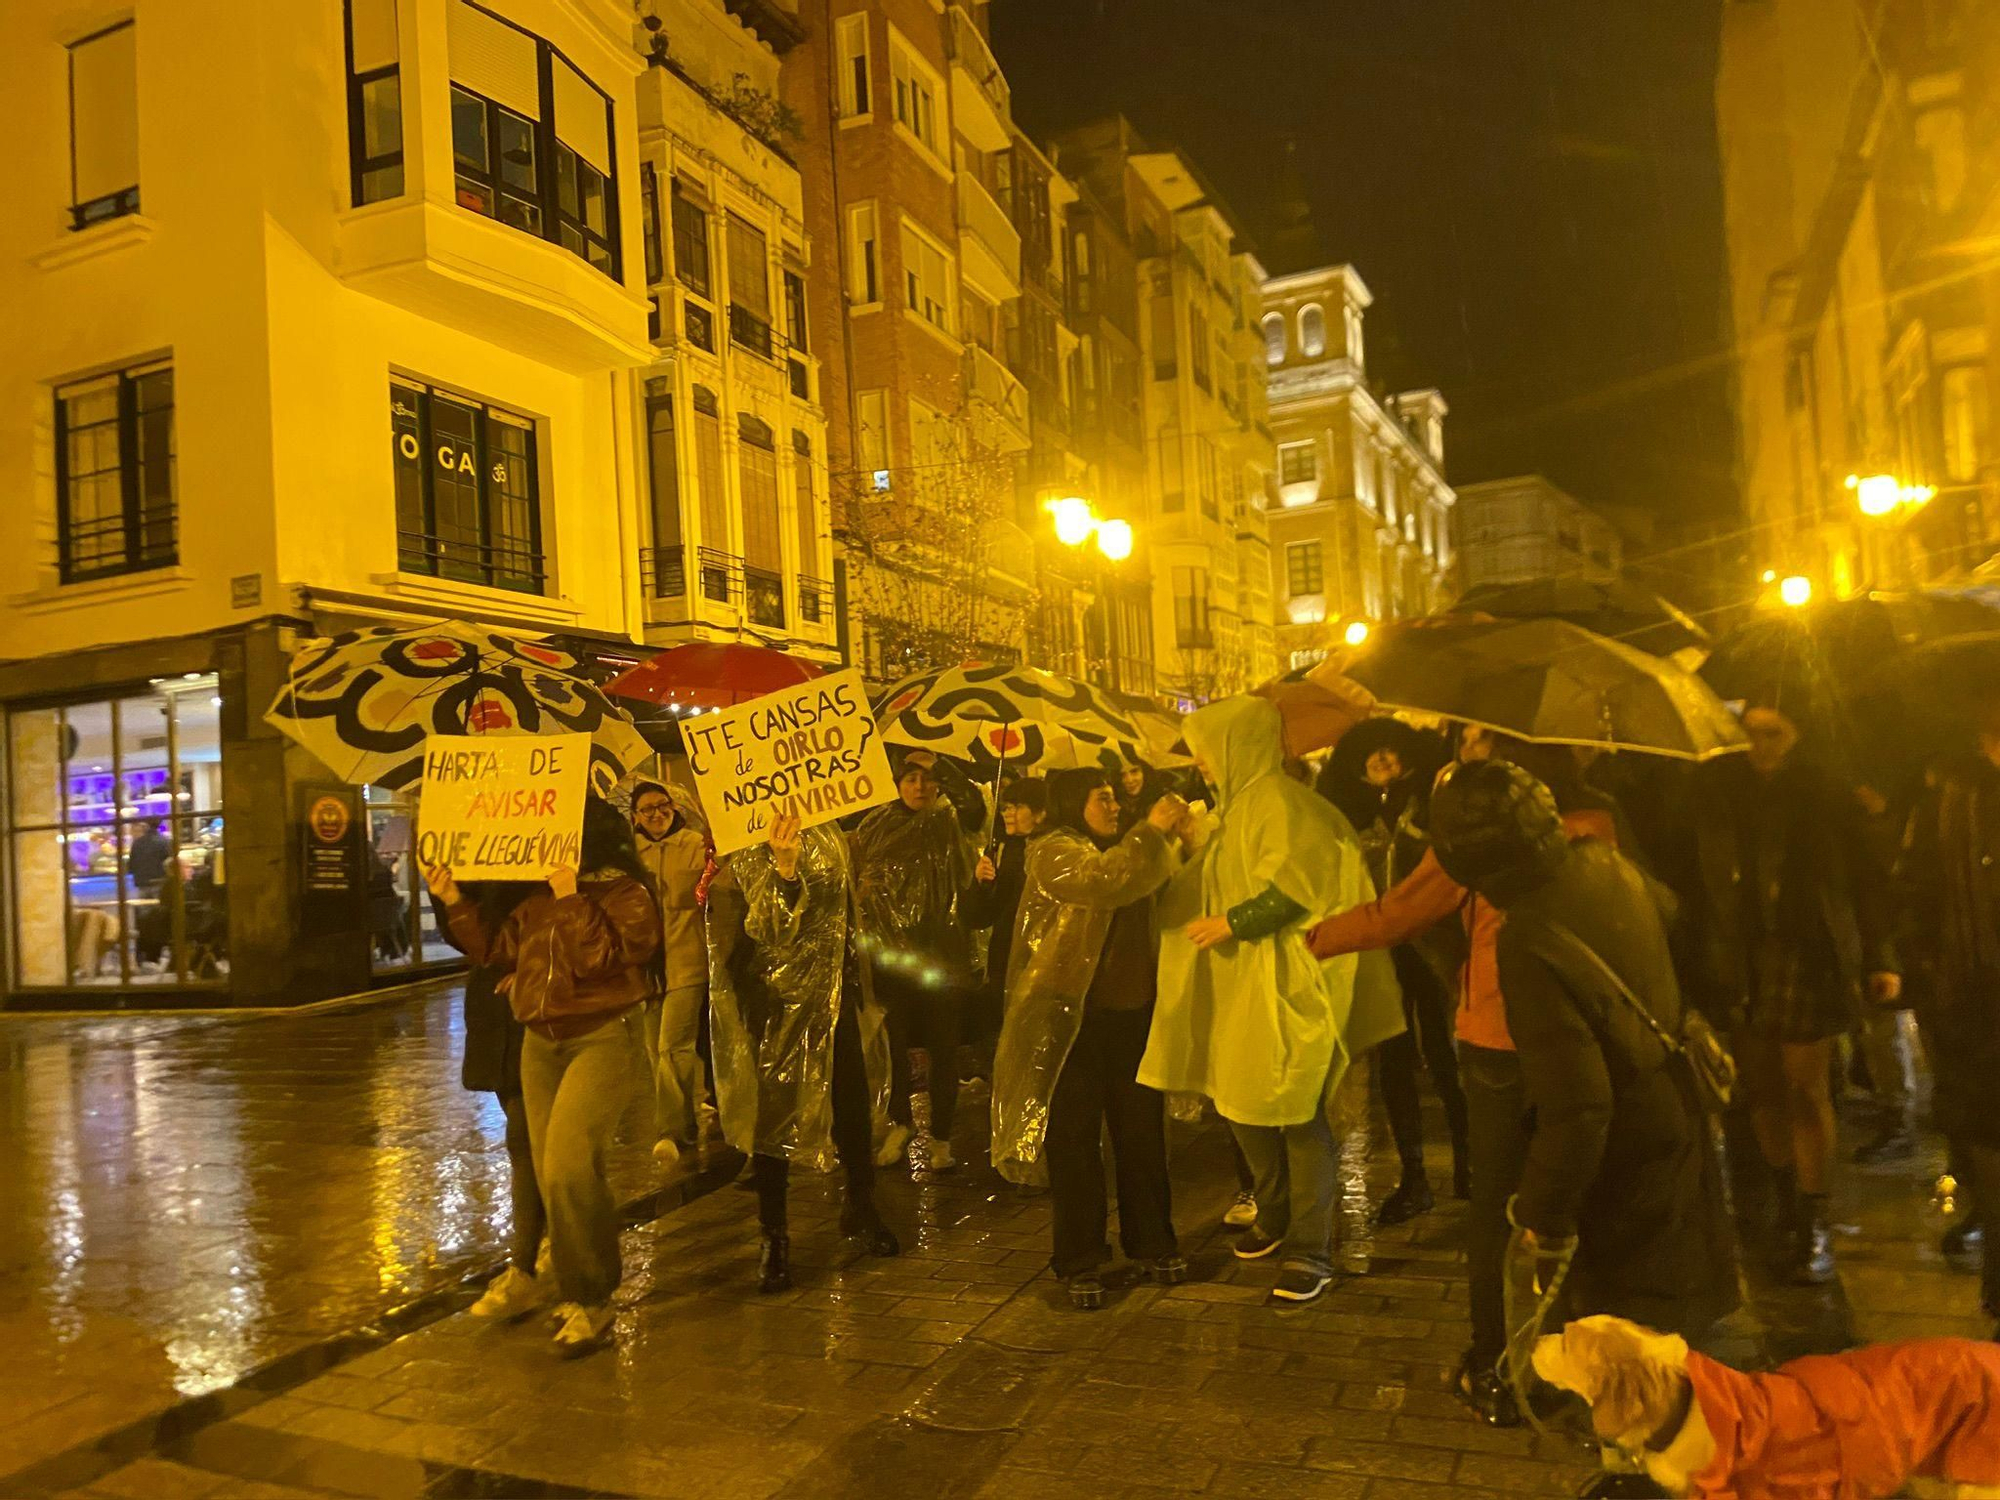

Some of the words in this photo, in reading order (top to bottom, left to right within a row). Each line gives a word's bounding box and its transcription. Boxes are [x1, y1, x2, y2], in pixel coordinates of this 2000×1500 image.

[392, 431, 475, 476] OGA
[750, 684, 857, 741] CANSAS
[427, 750, 500, 782] HARTA
[530, 746, 563, 776] DE
[722, 749, 861, 812] NOSOTRAS
[735, 749, 754, 776] de
[466, 788, 557, 819] AVISAR
[747, 809, 767, 834] de
[770, 774, 874, 820] VIVIRLO
[419, 830, 471, 867] QUE
[538, 830, 580, 867] VIVA
